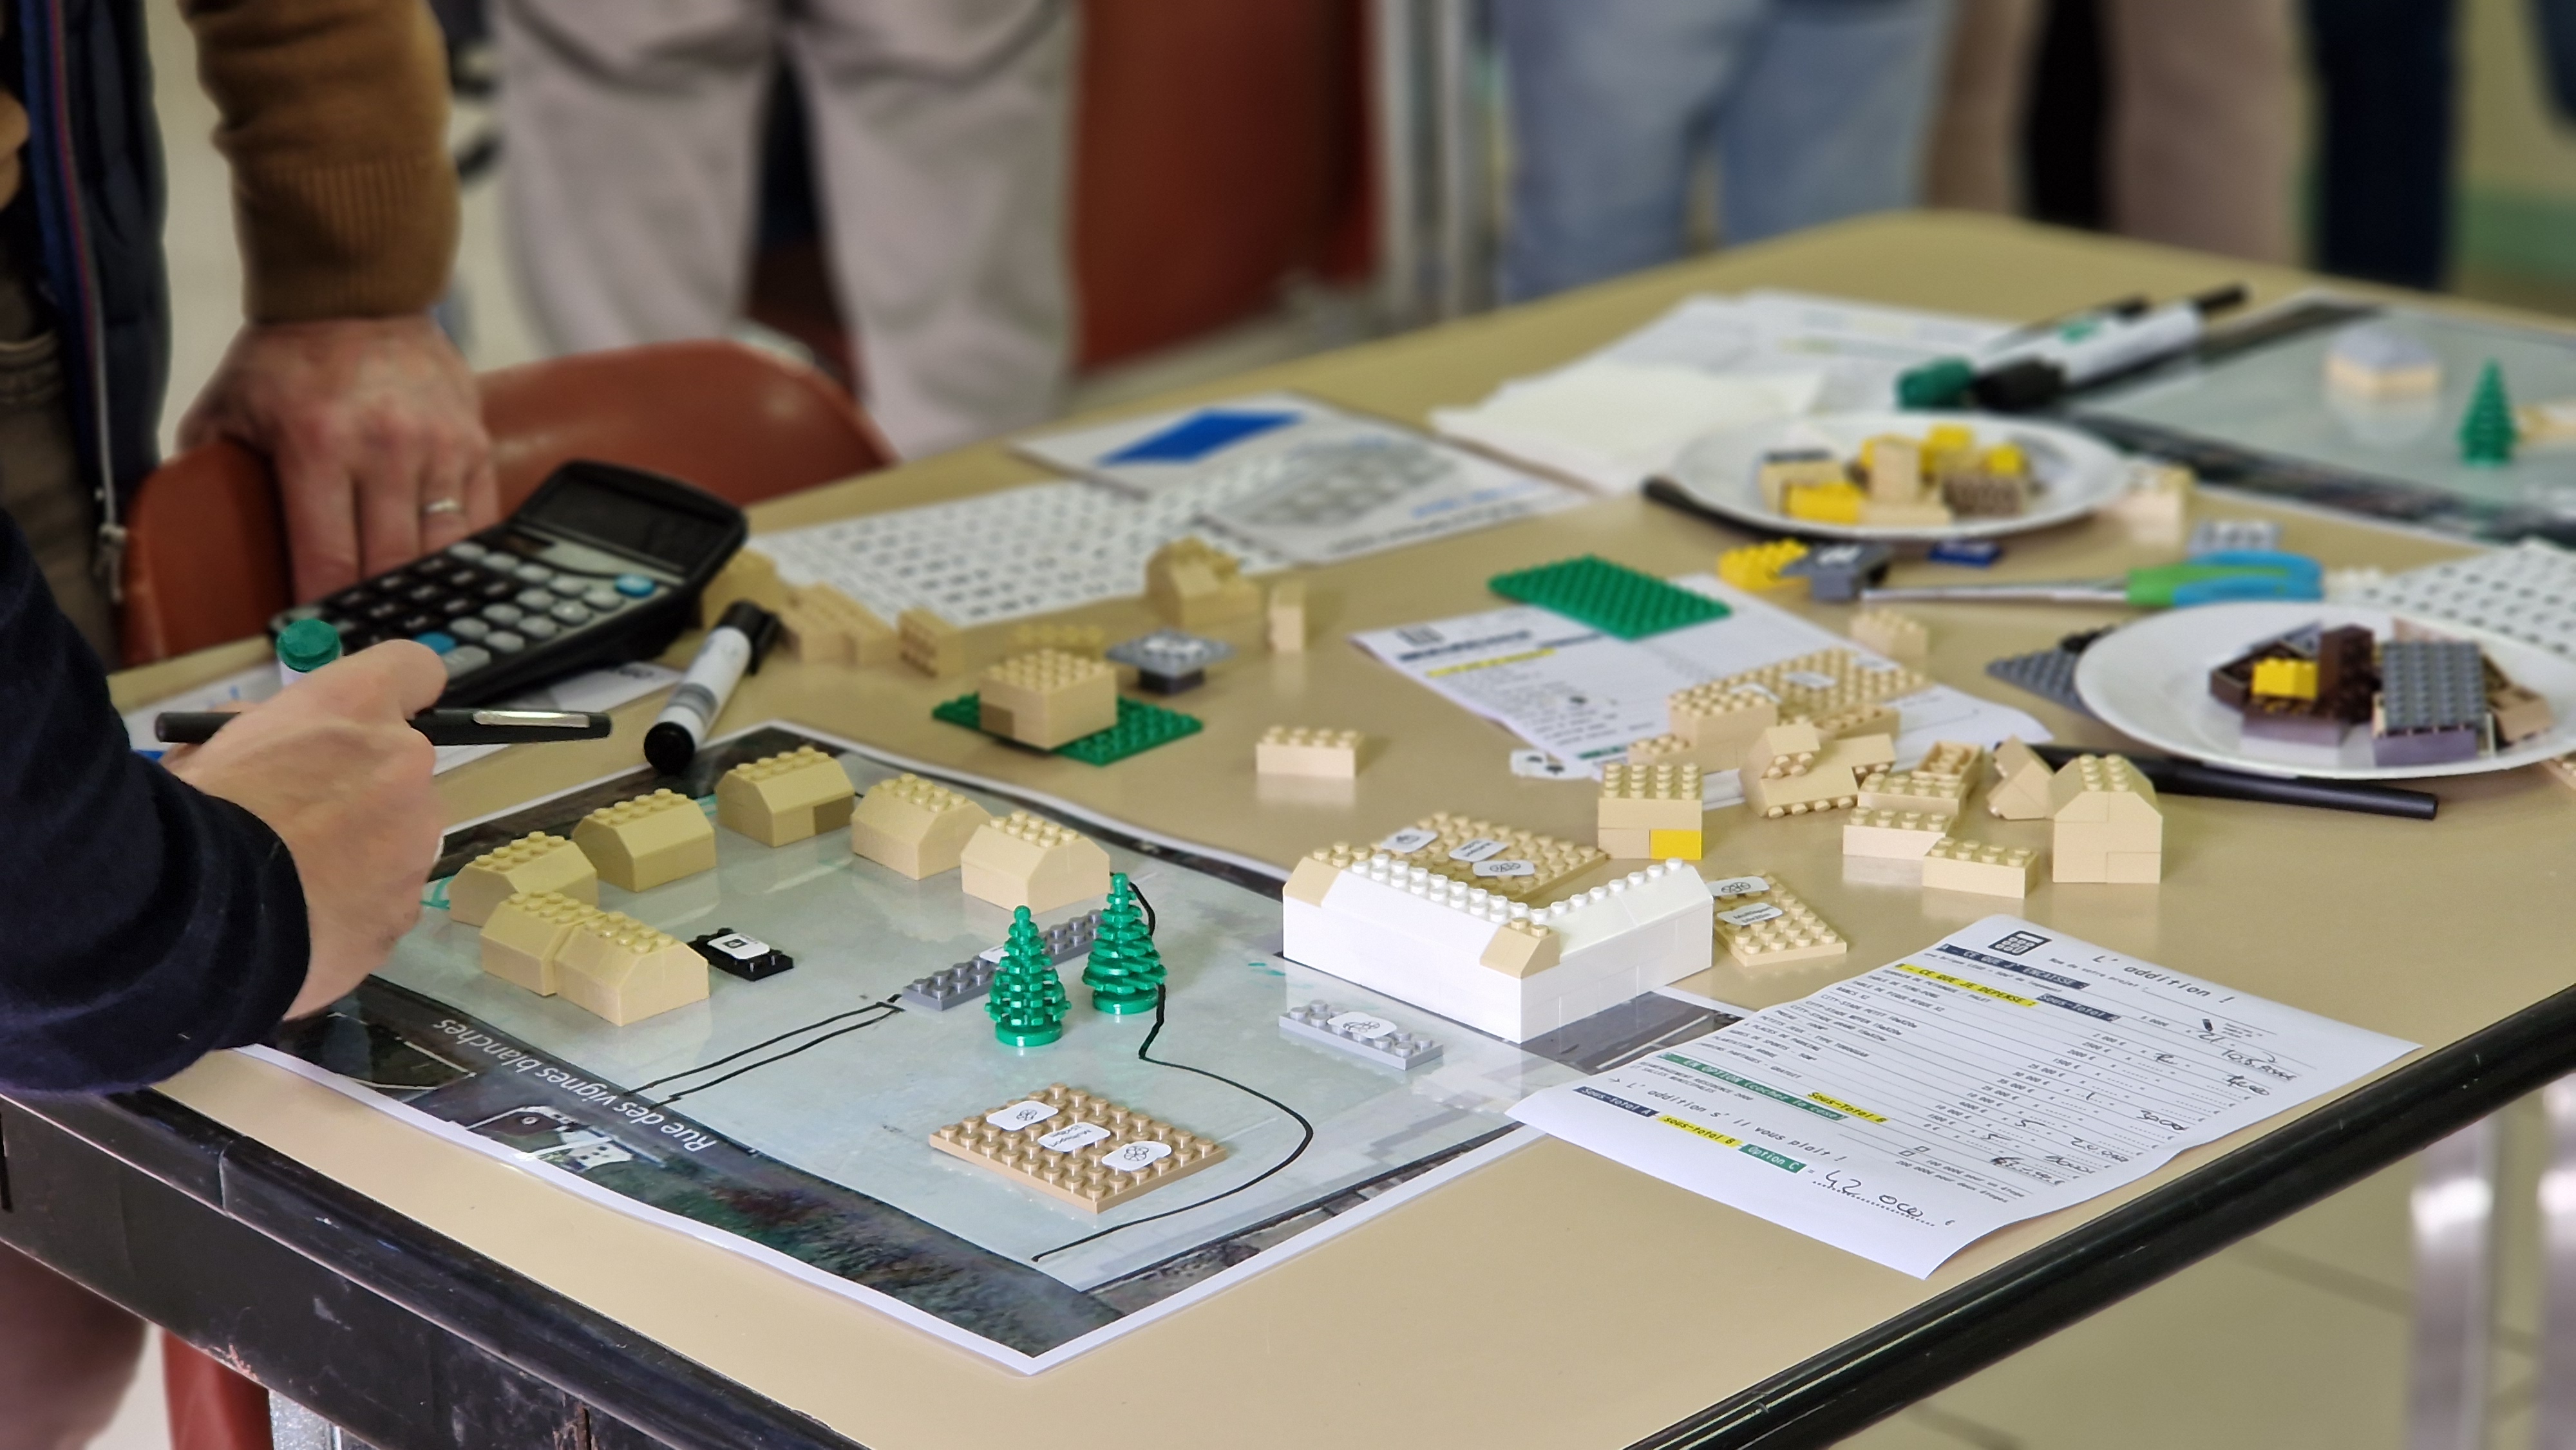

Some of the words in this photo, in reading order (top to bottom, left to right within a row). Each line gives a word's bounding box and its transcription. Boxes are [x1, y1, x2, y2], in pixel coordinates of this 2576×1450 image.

[1981, 955, 2003, 964] QUE
[2023, 966, 2075, 984] ENCAISSE
[2081, 968, 2106, 977] votre
[2107, 976, 2139, 987] projet
[2124, 966, 2210, 996] addition
[1821, 993, 1862, 1010] CITY-STADE
[1935, 974, 1958, 983] QUE
[1977, 986, 2025, 1003] DEPENSE
[1790, 1004, 1832, 1022] CITY-STADE
[1805, 1001, 1847, 1016] CITY-STADE
[2040, 993, 2105, 1016] Sous-Total
[433, 1018, 542, 1074] blanches
[535, 1069, 618, 1106] vignes
[1683, 1059, 1701, 1068] EN
[1701, 1065, 1743, 1082] OPTION
[1792, 1098, 1811, 1107] la
[1810, 1105, 1846, 1120] case)
[614, 1101, 664, 1130] des
[1647, 1090, 1706, 1112] addition
[1732, 1118, 1751, 1127] il
[1754, 1127, 1785, 1140] vous
[1808, 1091, 1873, 1118] Sous-Total
[661, 1122, 717, 1152] Rue
[1581, 1088, 1638, 1110] Sous-total
[1663, 1117, 1716, 1138] sous-total
[1745, 1146, 1785, 1165] Option
[1788, 1161, 1799, 1170] C
